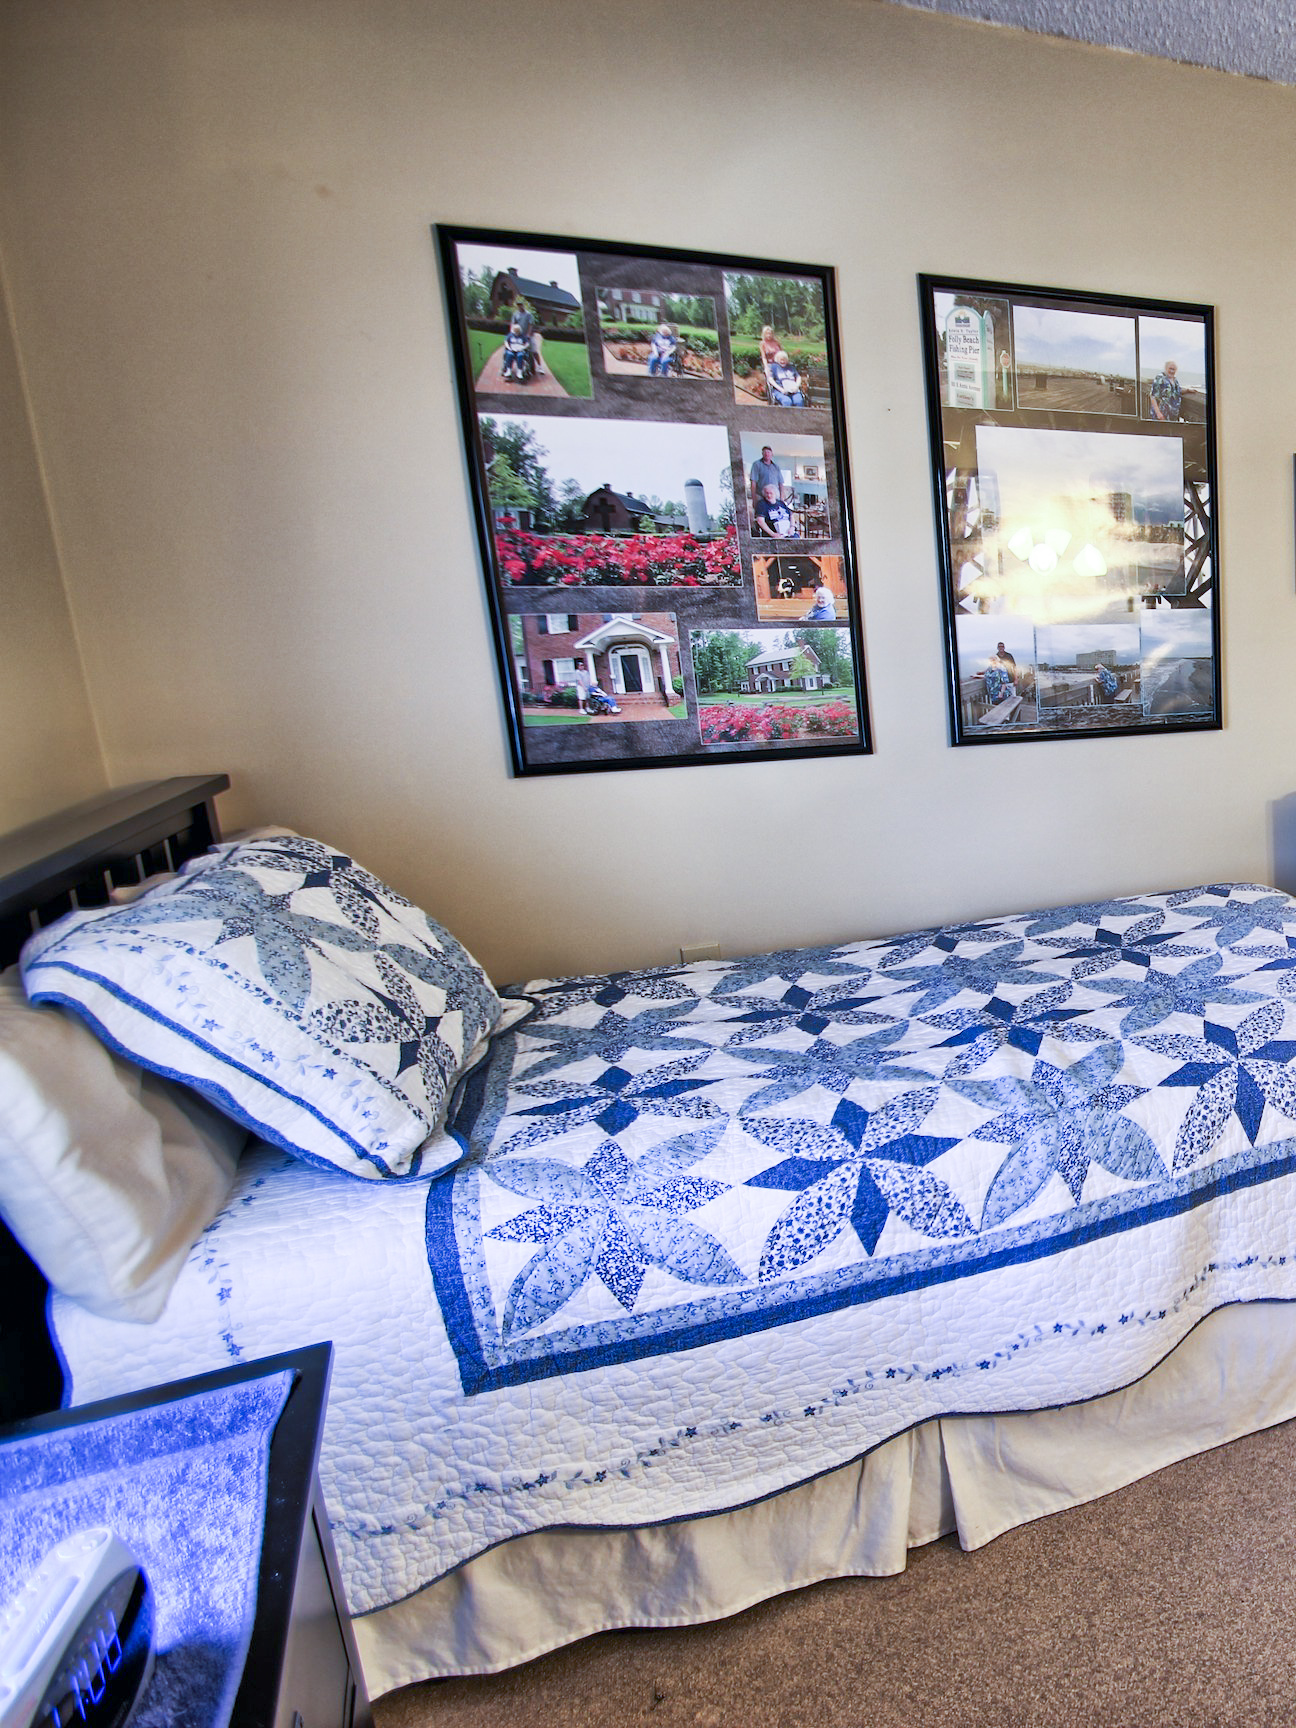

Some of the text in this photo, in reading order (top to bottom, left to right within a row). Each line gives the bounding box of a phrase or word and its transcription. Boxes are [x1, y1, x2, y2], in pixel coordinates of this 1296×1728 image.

[948, 335, 980, 345] Folly Beach
[949, 344, 980, 355] Fishing Pier
